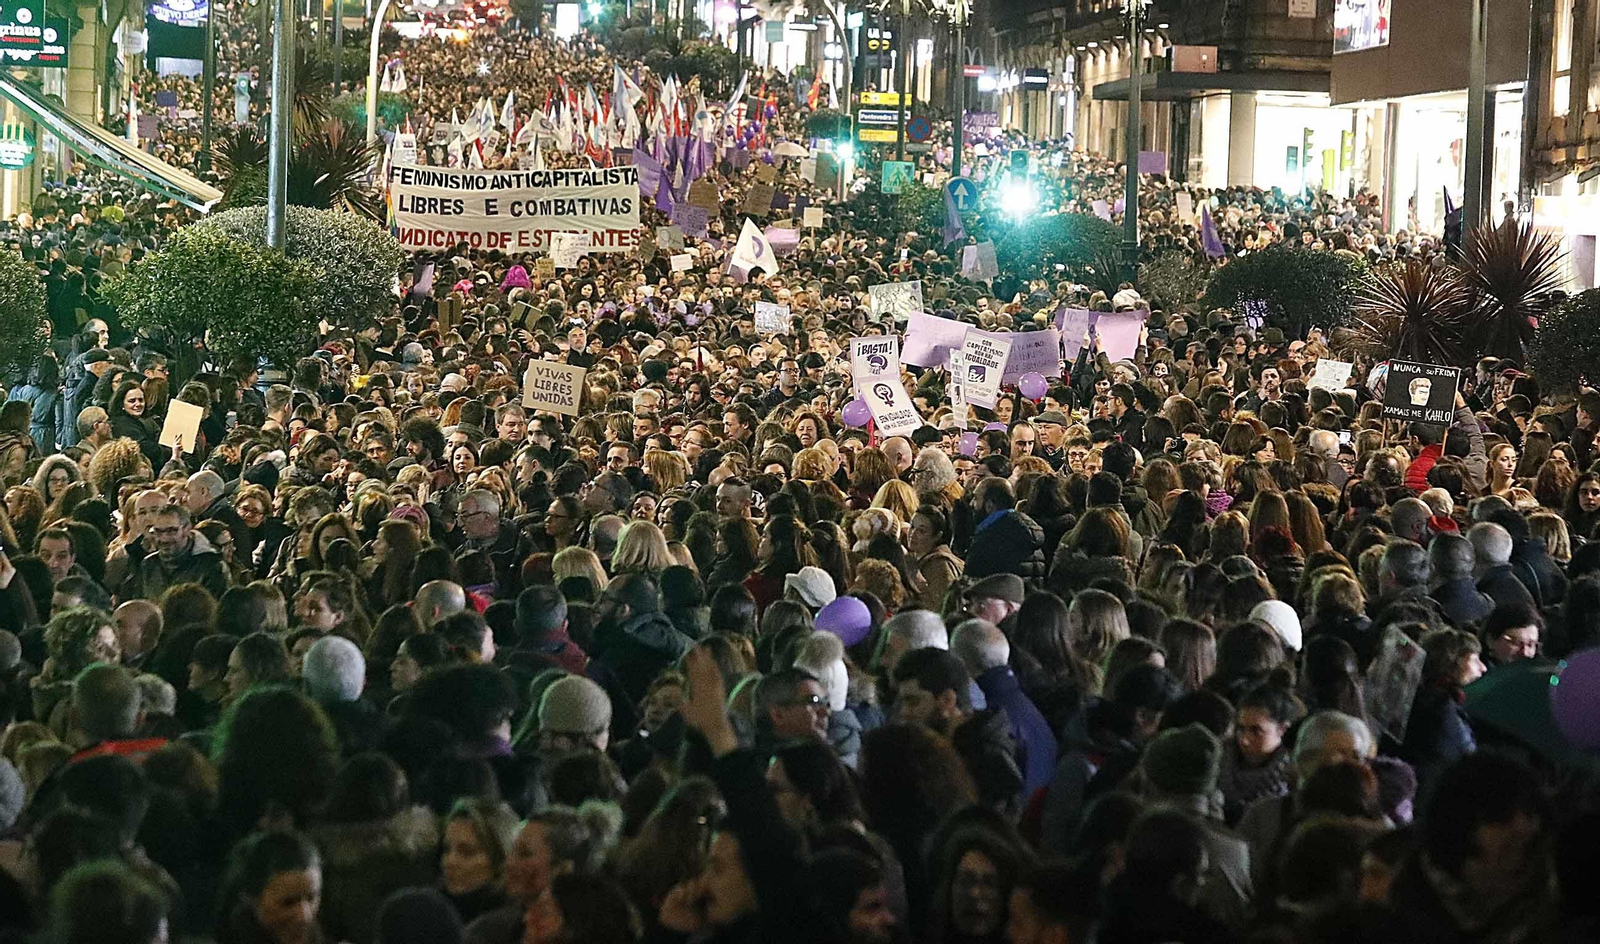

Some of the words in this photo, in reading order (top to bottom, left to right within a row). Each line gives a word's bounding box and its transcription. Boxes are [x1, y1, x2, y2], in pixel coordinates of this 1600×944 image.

[390, 166, 487, 190] FEMINISMO
[490, 167, 639, 190] ANTICAPITALISTA
[398, 194, 465, 216] LIBRES
[485, 198, 499, 216] E
[510, 197, 632, 217] COMBATIVAS
[486, 231, 512, 249] DE
[857, 341, 893, 357] ¡BASTA!
[965, 353, 999, 369] IGUALDADE
[1393, 364, 1421, 373] NUNCA
[537, 367, 572, 382] VIVAS
[534, 379, 572, 395] LIBRES
[532, 391, 573, 406] UNIDAS
[1383, 406, 1410, 417] XAMAIS
[1411, 410, 1422, 418] ME
[1424, 407, 1451, 422] KAHLO
